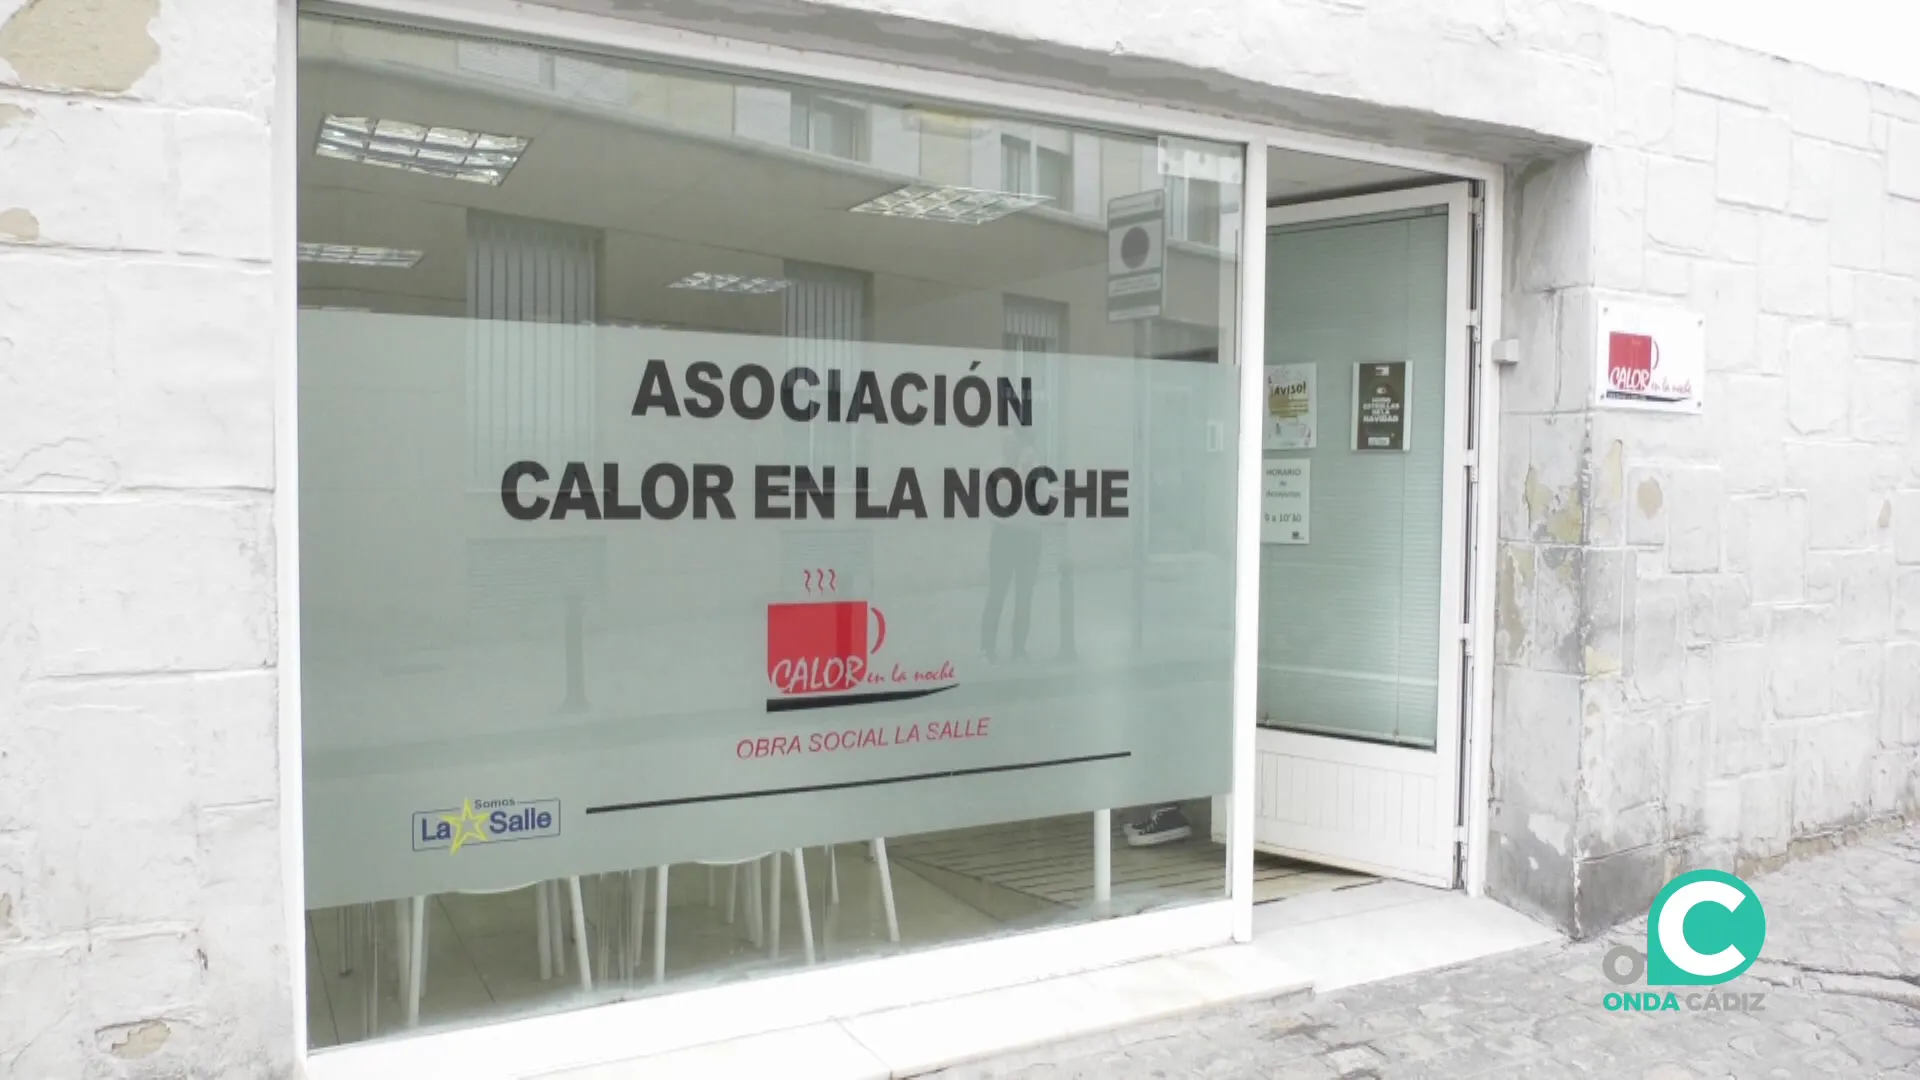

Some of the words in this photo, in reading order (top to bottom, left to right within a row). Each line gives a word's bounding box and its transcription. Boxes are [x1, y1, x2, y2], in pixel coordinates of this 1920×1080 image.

[631, 359, 1033, 427] ASOCIACIÓN
[1610, 365, 1650, 391] CALOR
[500, 460, 736, 520] CALOR
[754, 464, 835, 519] EN
[856, 466, 928, 518] LA
[943, 467, 1130, 518] NOCHE
[1266, 468, 1302, 476] HORARIO
[771, 655, 864, 693] CALOR
[867, 672, 885, 683] en
[891, 663, 908, 682] la
[915, 661, 956, 682] noche
[736, 735, 802, 760] OBRA
[808, 727, 889, 753] SOCIAL
[894, 724, 920, 744] LA
[926, 717, 991, 740] SALLE
[474, 798, 516, 810] Somos
[422, 817, 451, 842] La
[489, 807, 553, 834] Salle
